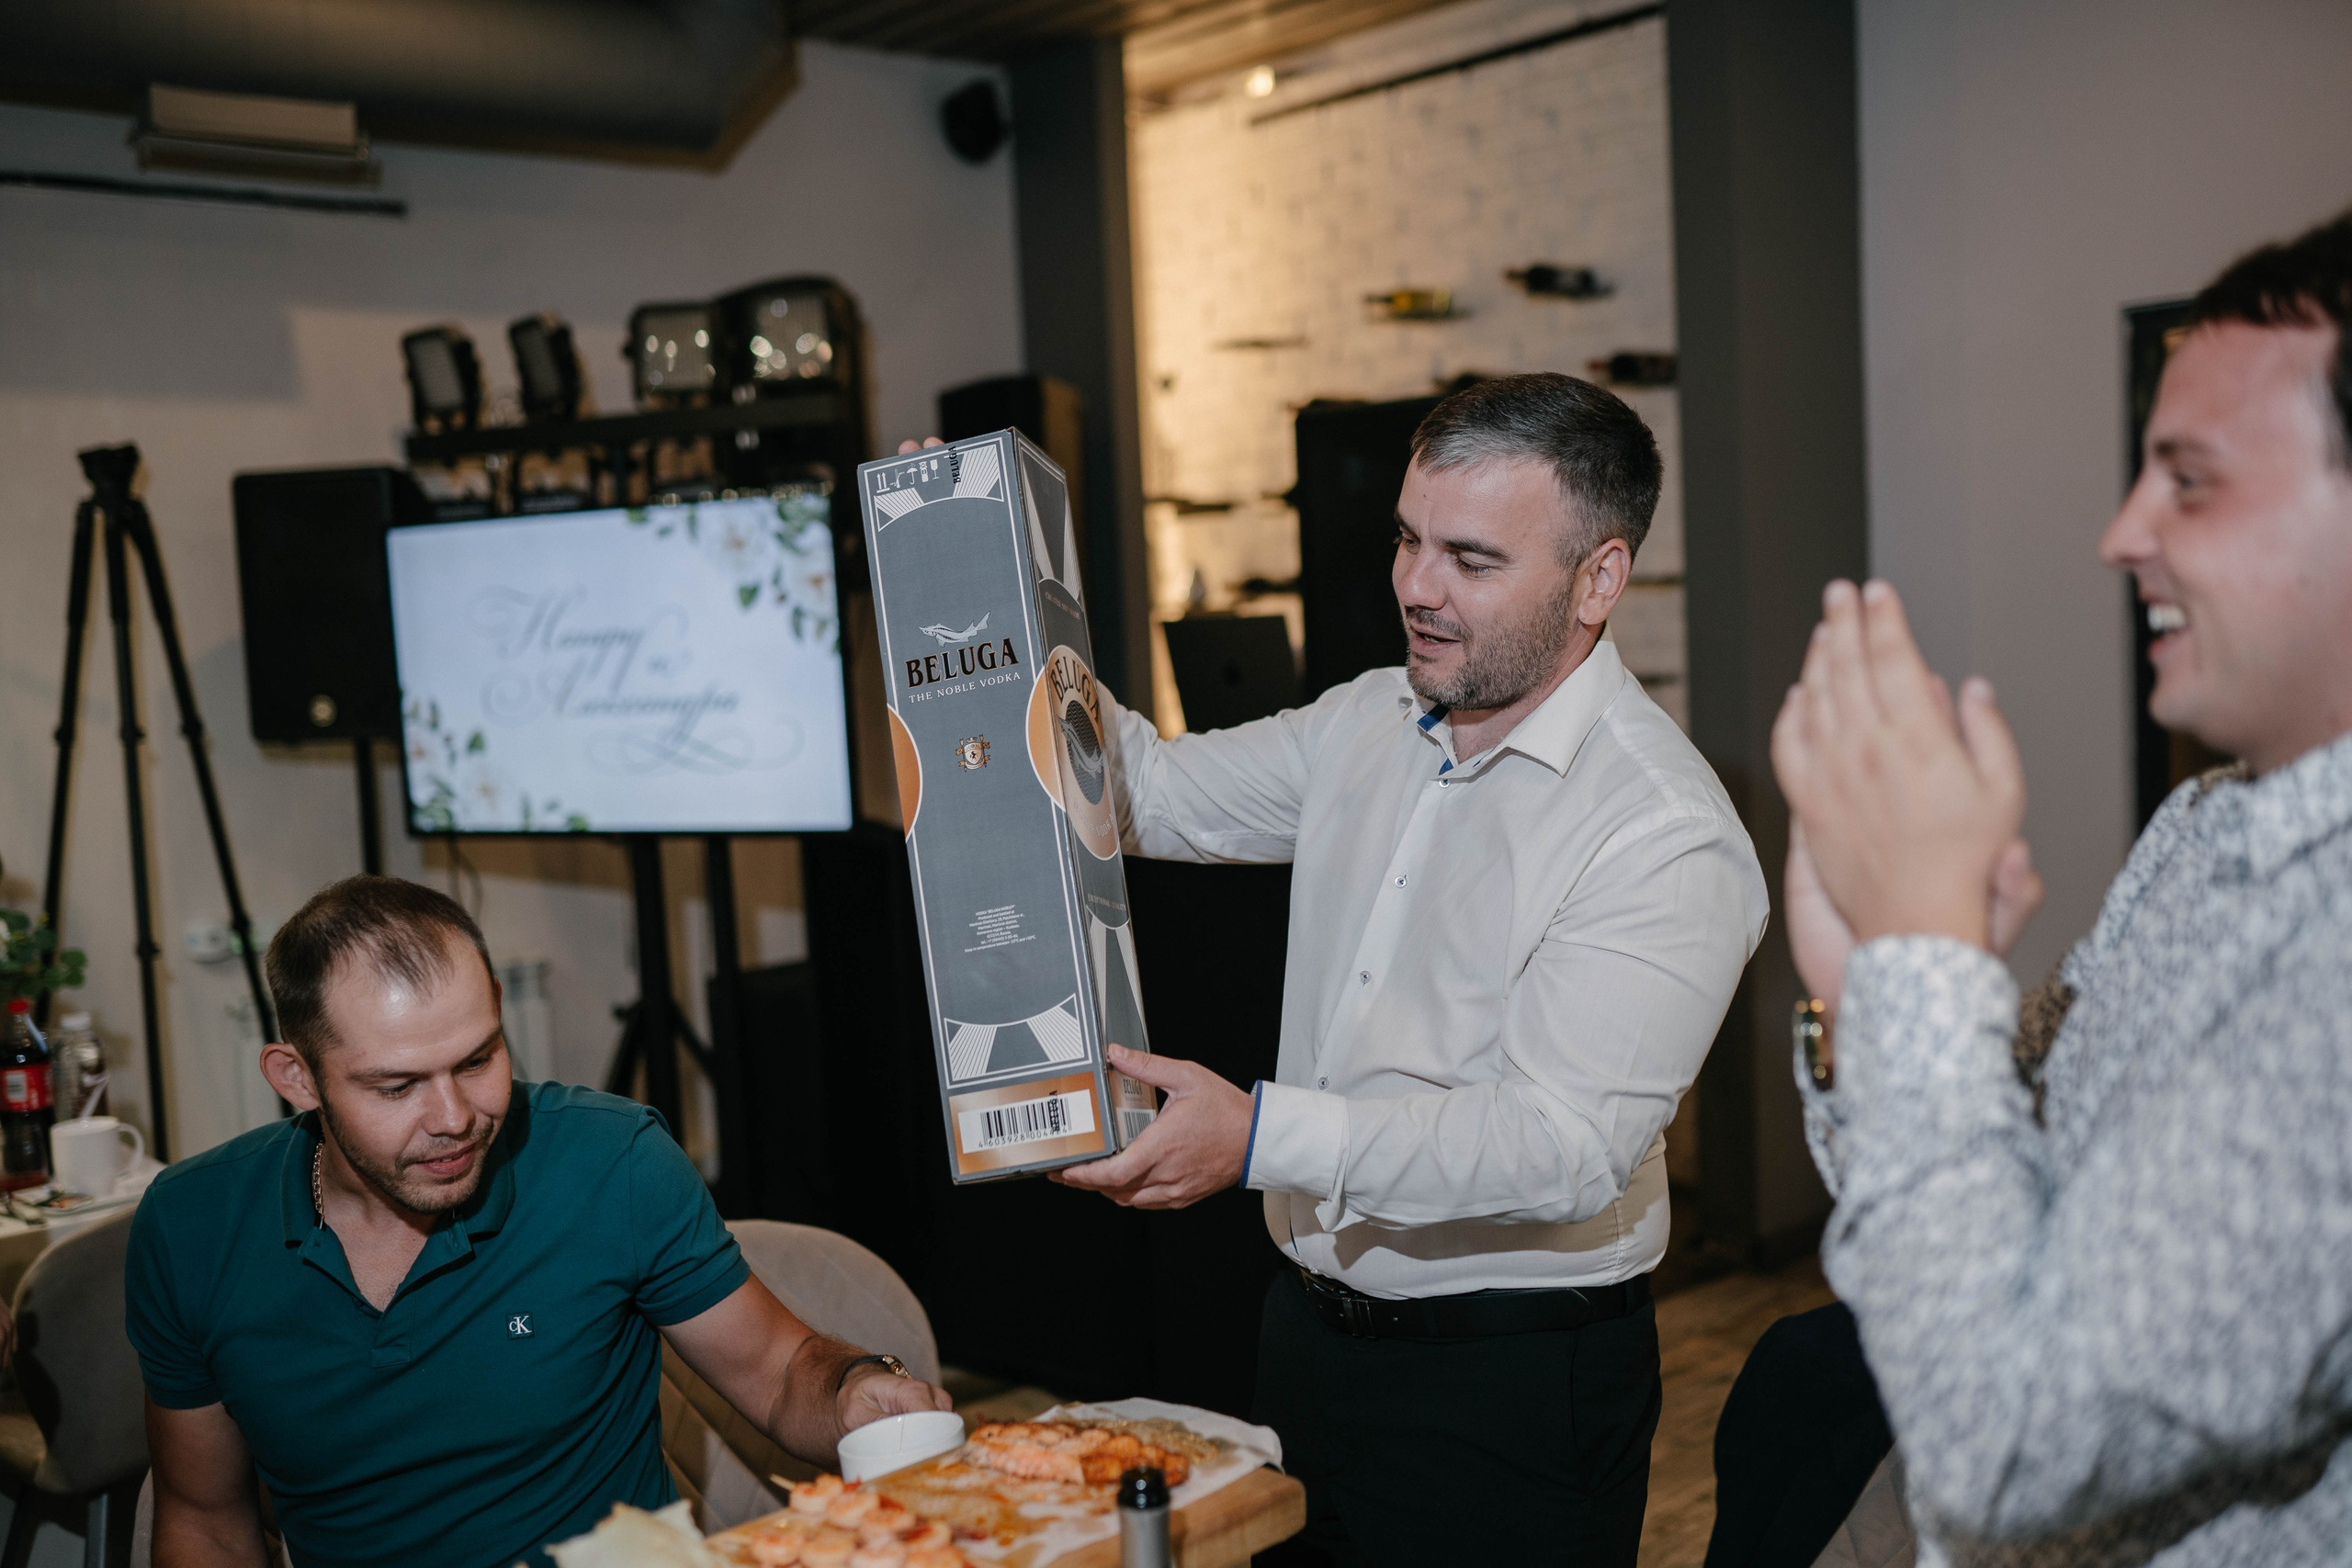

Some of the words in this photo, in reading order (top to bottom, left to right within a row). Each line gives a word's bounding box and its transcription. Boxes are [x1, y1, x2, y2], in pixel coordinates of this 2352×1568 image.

[948, 446, 961, 484] BELUGA
[905, 637, 1019, 688] BELUGA
[908, 691, 933, 704] THE
[937, 682, 976, 698] NOBLE
[980, 671, 1021, 688] VODKA
[1051, 655, 1101, 723] BELUGA
